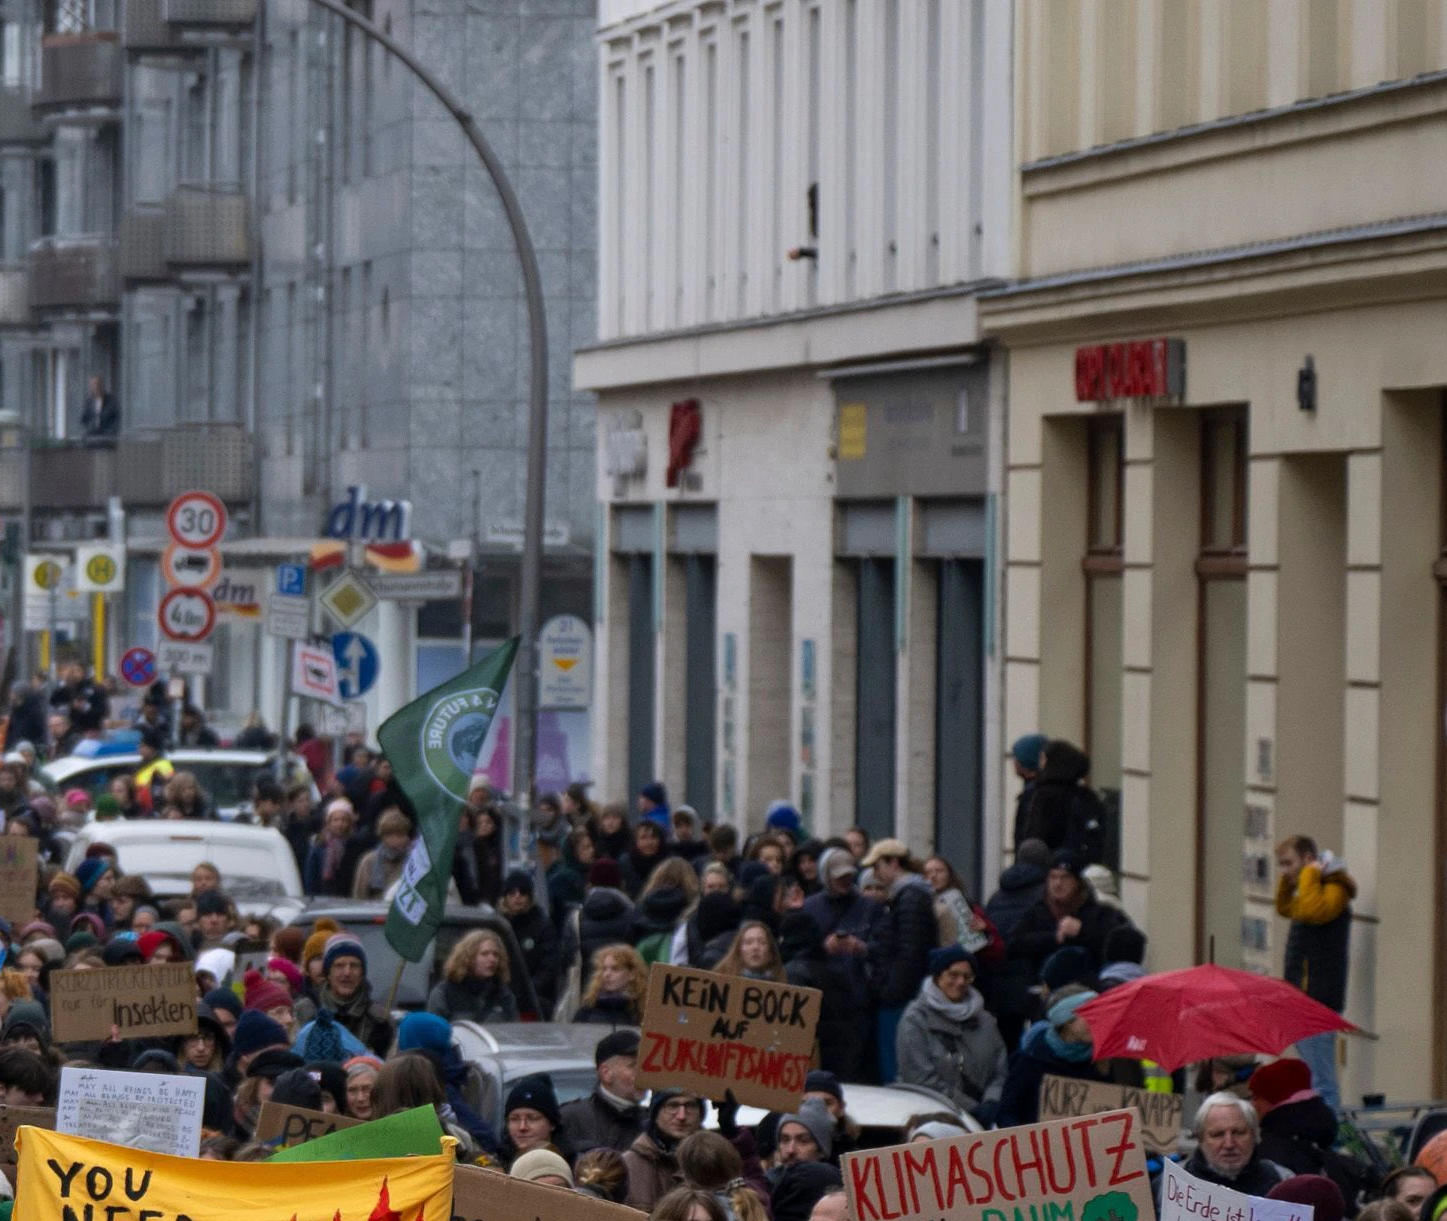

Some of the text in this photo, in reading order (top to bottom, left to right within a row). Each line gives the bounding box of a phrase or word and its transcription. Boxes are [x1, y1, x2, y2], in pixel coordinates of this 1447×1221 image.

[181, 509, 213, 534] 30
[321, 486, 405, 539] dm
[213, 580, 255, 601] dm
[282, 570, 297, 587] P
[112, 998, 193, 1028] Insekten
[742, 986, 809, 1029] BOCK
[711, 1016, 750, 1040] AUF
[641, 1031, 810, 1093] ZUKUNFTSANGST
[47, 1158, 153, 1202] YOU
[1167, 1174, 1184, 1208] Die
